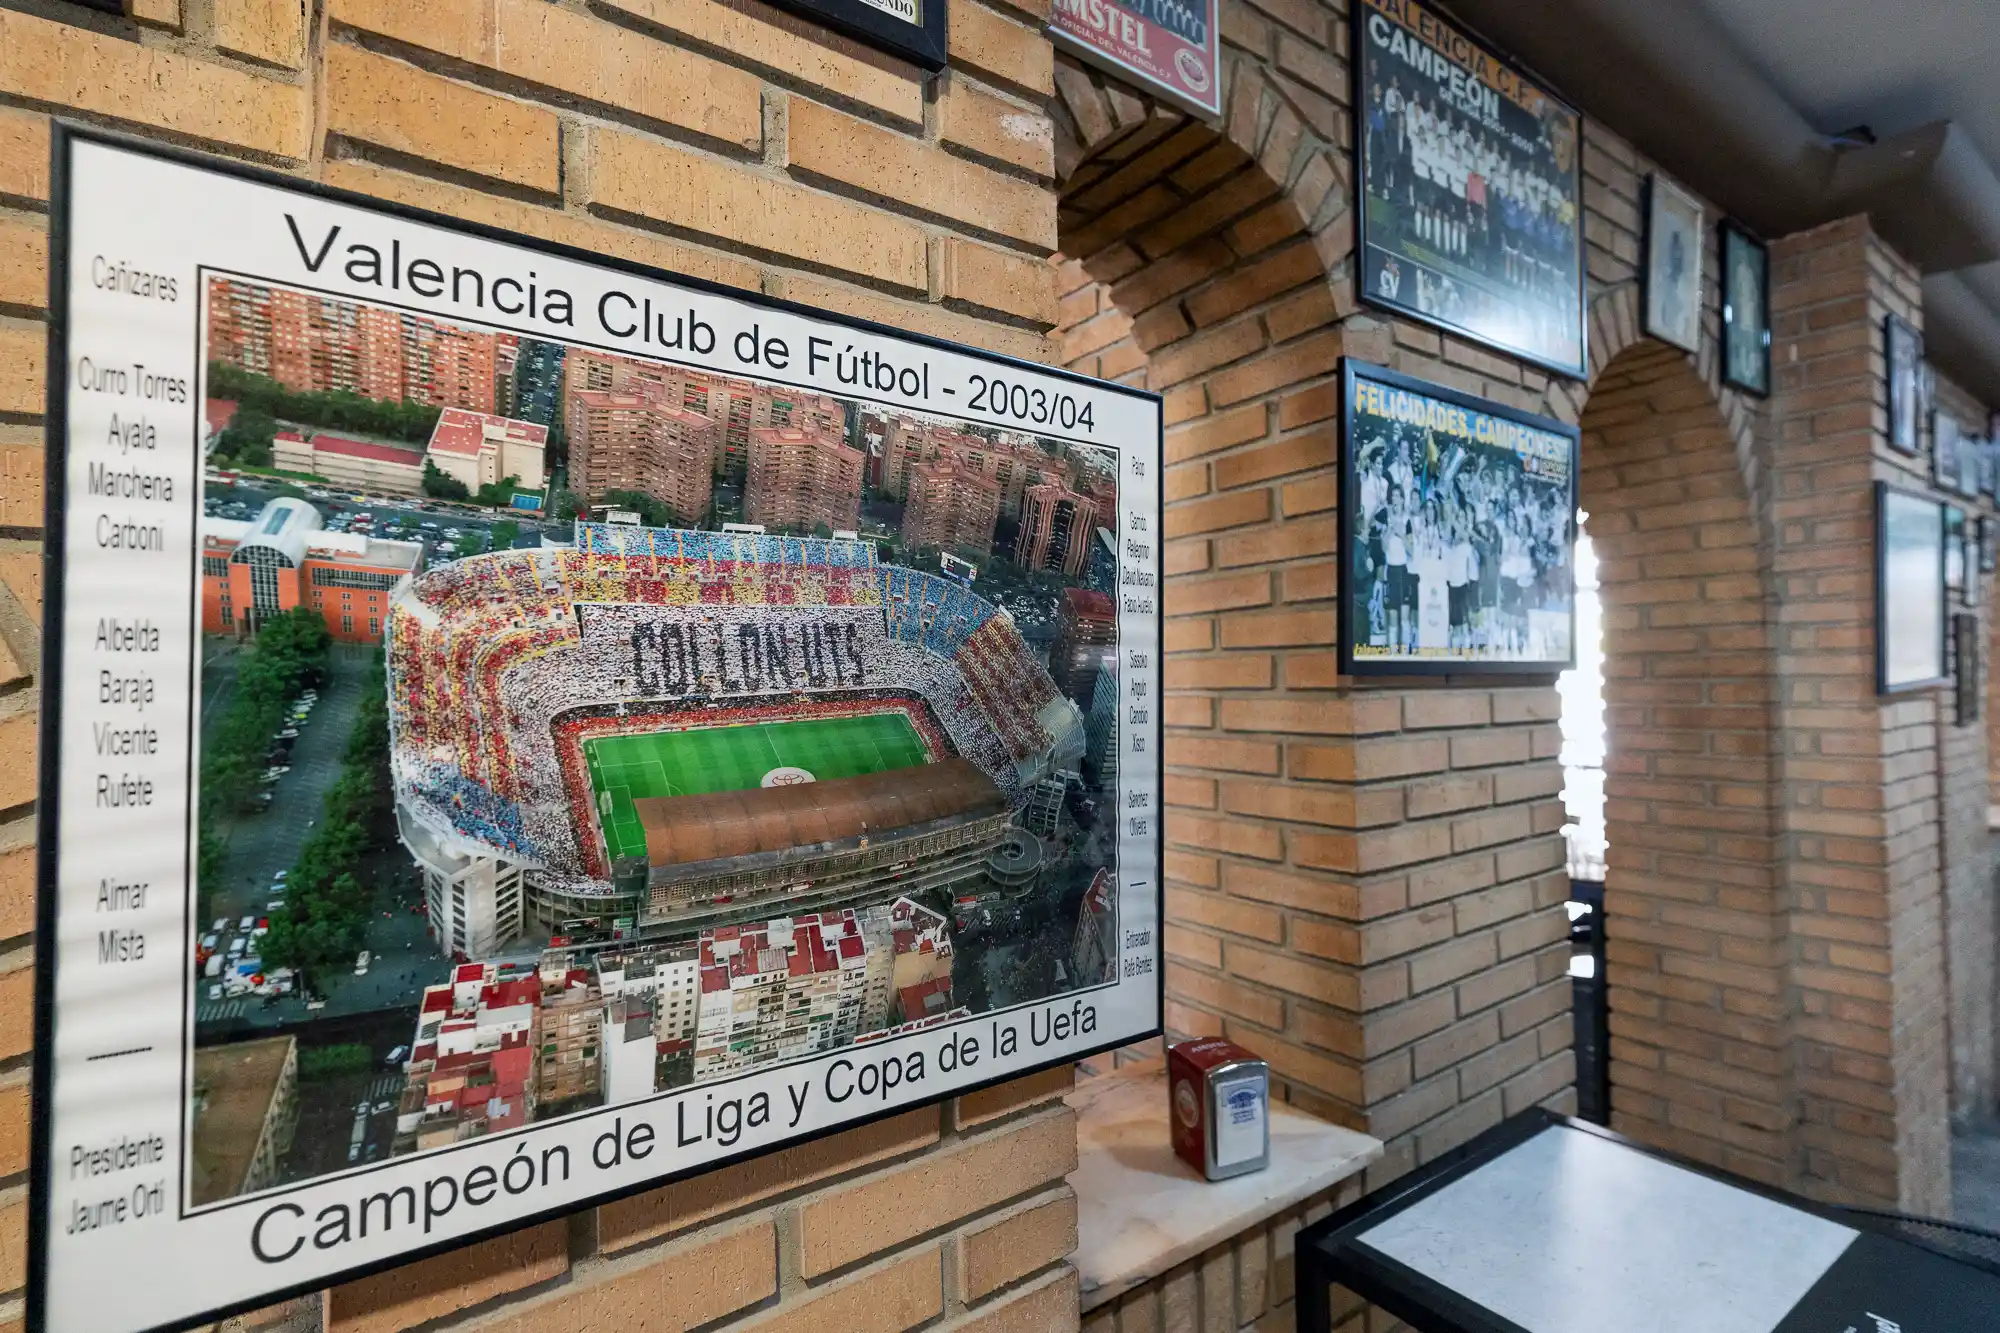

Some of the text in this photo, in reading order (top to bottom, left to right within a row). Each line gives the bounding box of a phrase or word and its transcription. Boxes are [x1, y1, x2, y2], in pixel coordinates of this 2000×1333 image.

[1098, 36, 1116, 52] DEL
[1117, 46, 1157, 74] VALENCIA
[1369, 14, 1499, 120] CAMPEÓN
[92, 254, 178, 303] Cañizares
[284, 213, 574, 327] Valencia
[598, 290, 716, 355] Club
[734, 323, 790, 370] de
[808, 336, 929, 399] Fútbol
[967, 374, 1096, 434] 2003/04
[78, 355, 187, 404] Curro Torres
[107, 412, 158, 456] Ayala
[88, 461, 175, 503] Marchena
[94, 617, 160, 652] Albelda
[99, 669, 155, 712] Baraja
[93, 721, 158, 756] Vicente
[96, 773, 154, 808] Rufete
[96, 877, 150, 912] Aimar
[98, 928, 146, 965] Mista
[250, 1000, 1098, 1264] Campeón de Liga y Copa de la Uefa
[70, 1133, 165, 1181] Presidente
[66, 1196, 127, 1235] Jaume
